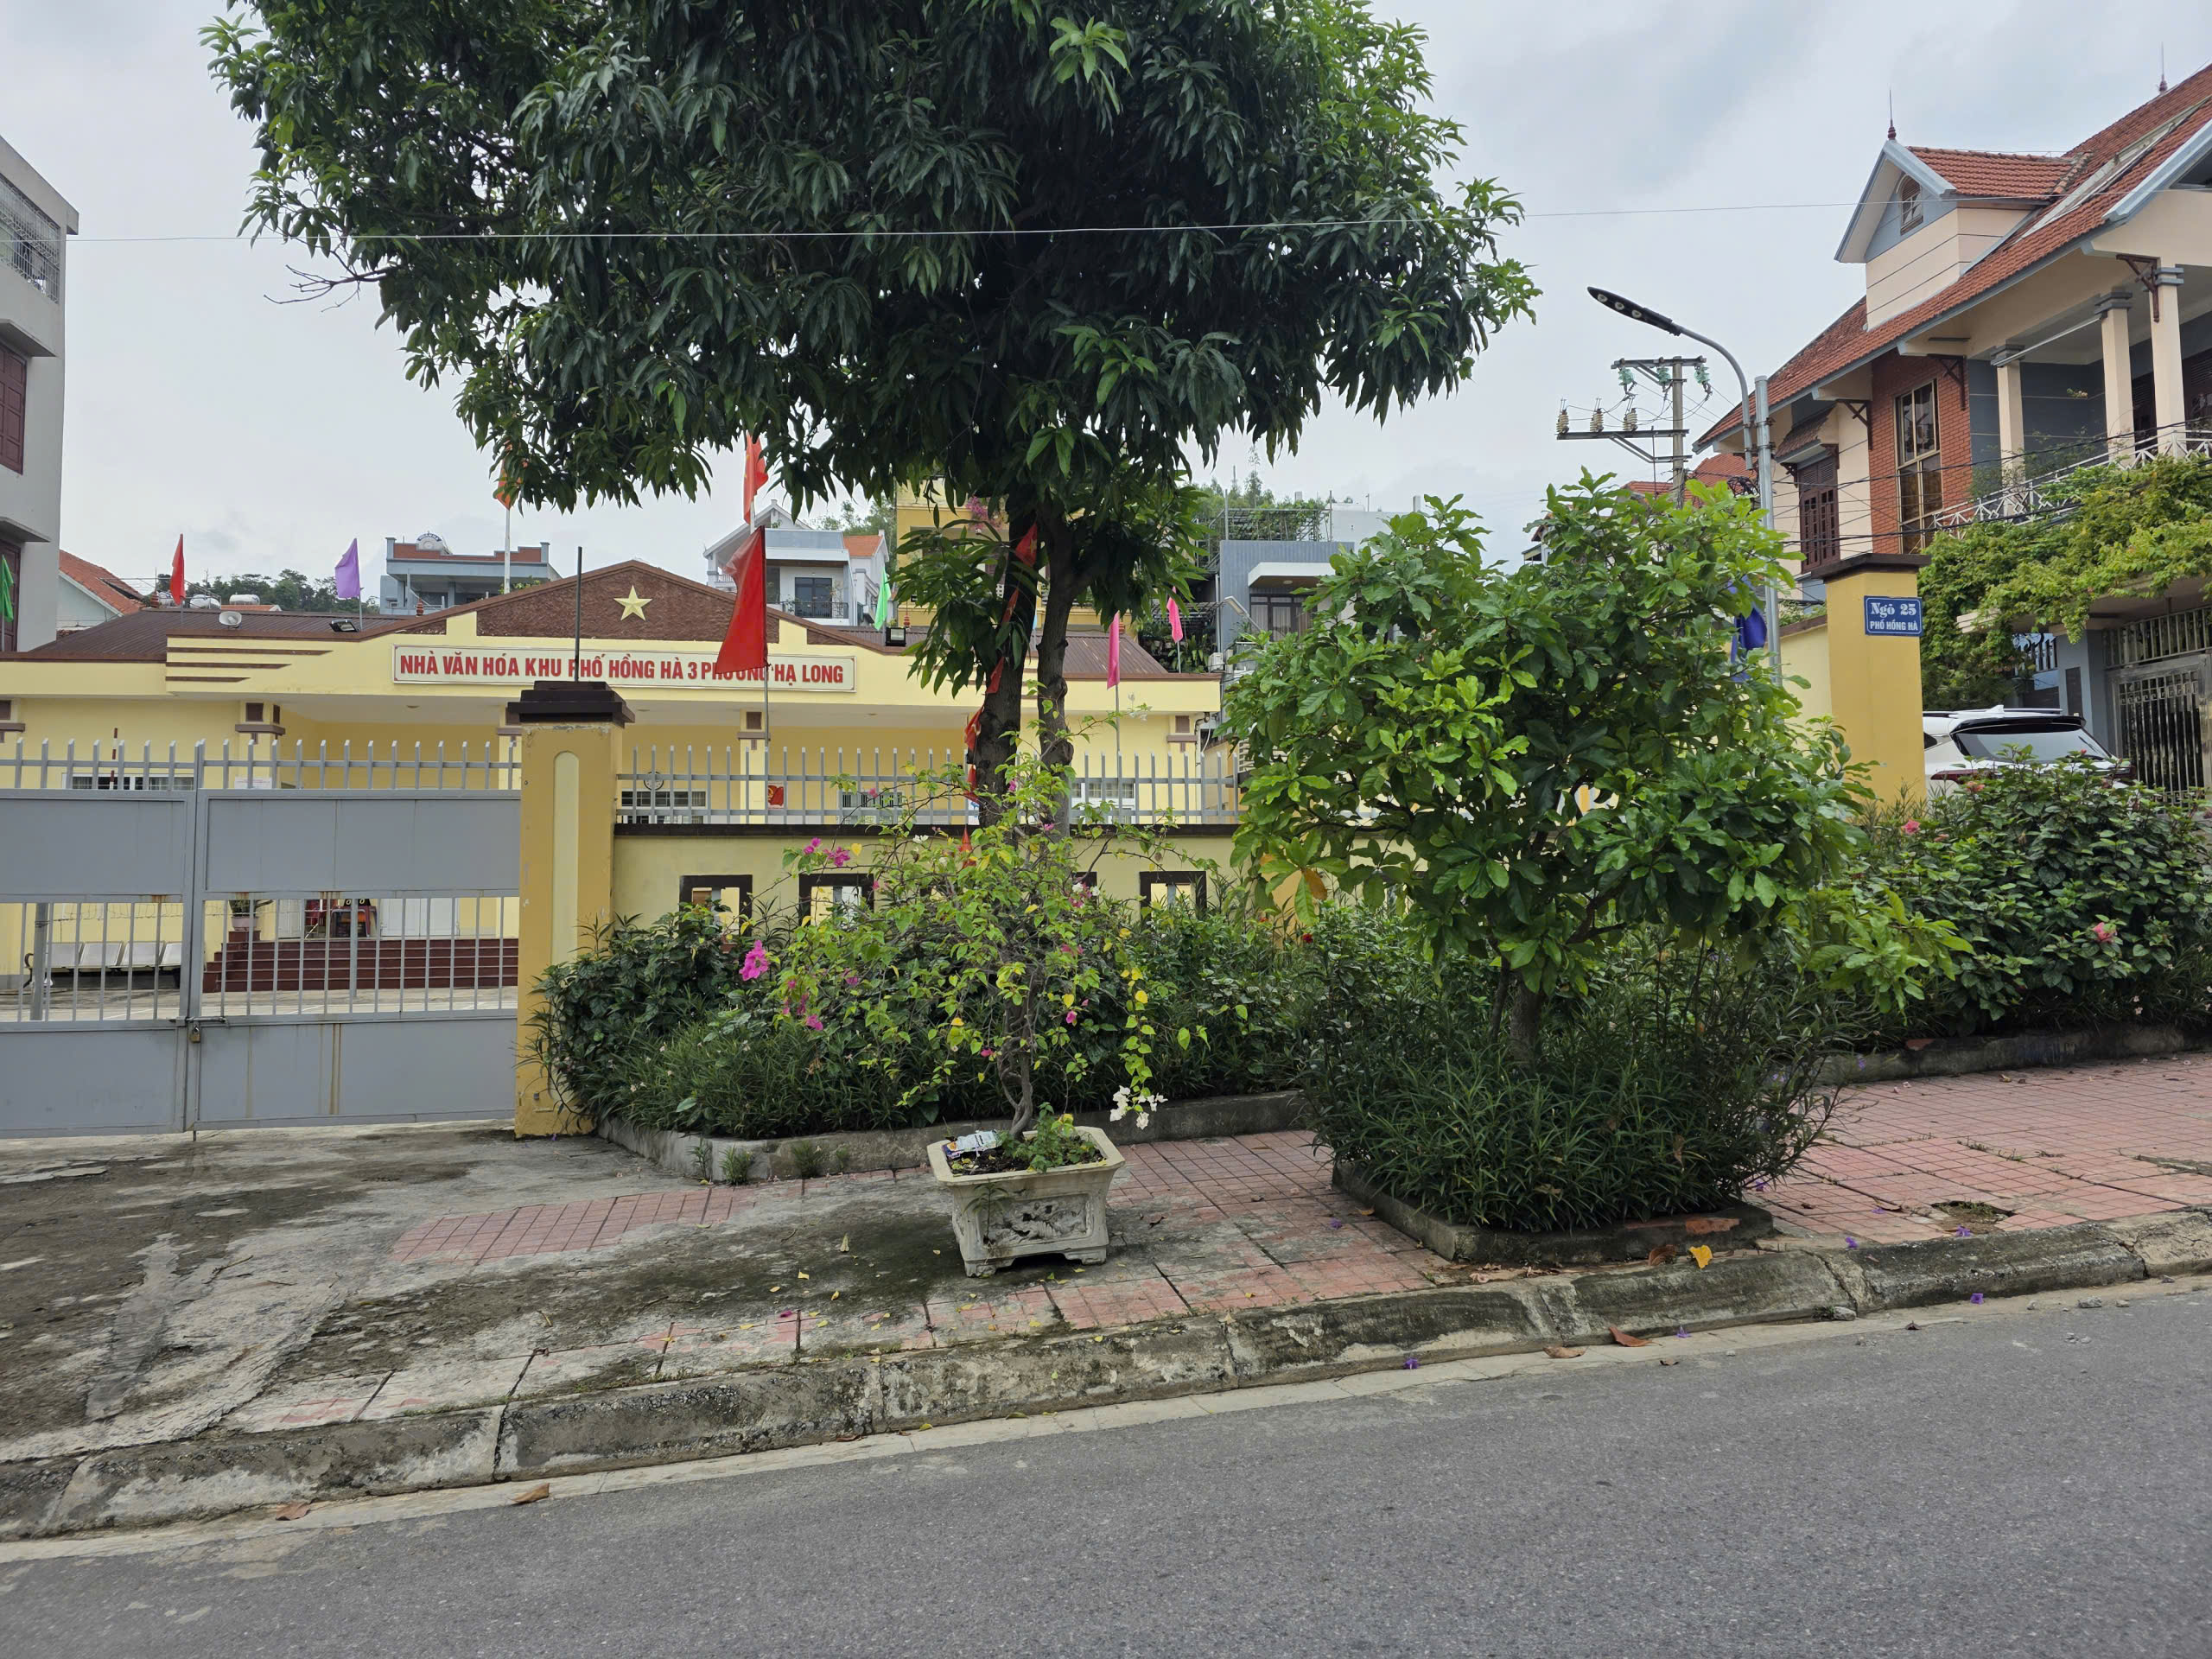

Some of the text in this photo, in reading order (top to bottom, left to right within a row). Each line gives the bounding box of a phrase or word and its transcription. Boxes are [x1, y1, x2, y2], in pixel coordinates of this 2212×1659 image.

[1900, 603, 1916, 616] 25
[1870, 619, 1885, 630] PHỐ
[1907, 620, 1918, 631] HÀ
[400, 651, 438, 675] NHÀ
[442, 652, 478, 676] VĂN
[483, 653, 519, 677] HÓA
[524, 658, 562, 677] KHU
[568, 653, 606, 677] PHỐ
[608, 653, 655, 678] HỒNG
[660, 657, 683, 680] HÀ
[687, 662, 697, 680] 3
[774, 664, 797, 686] HẠ
[802, 664, 843, 683] LONG
